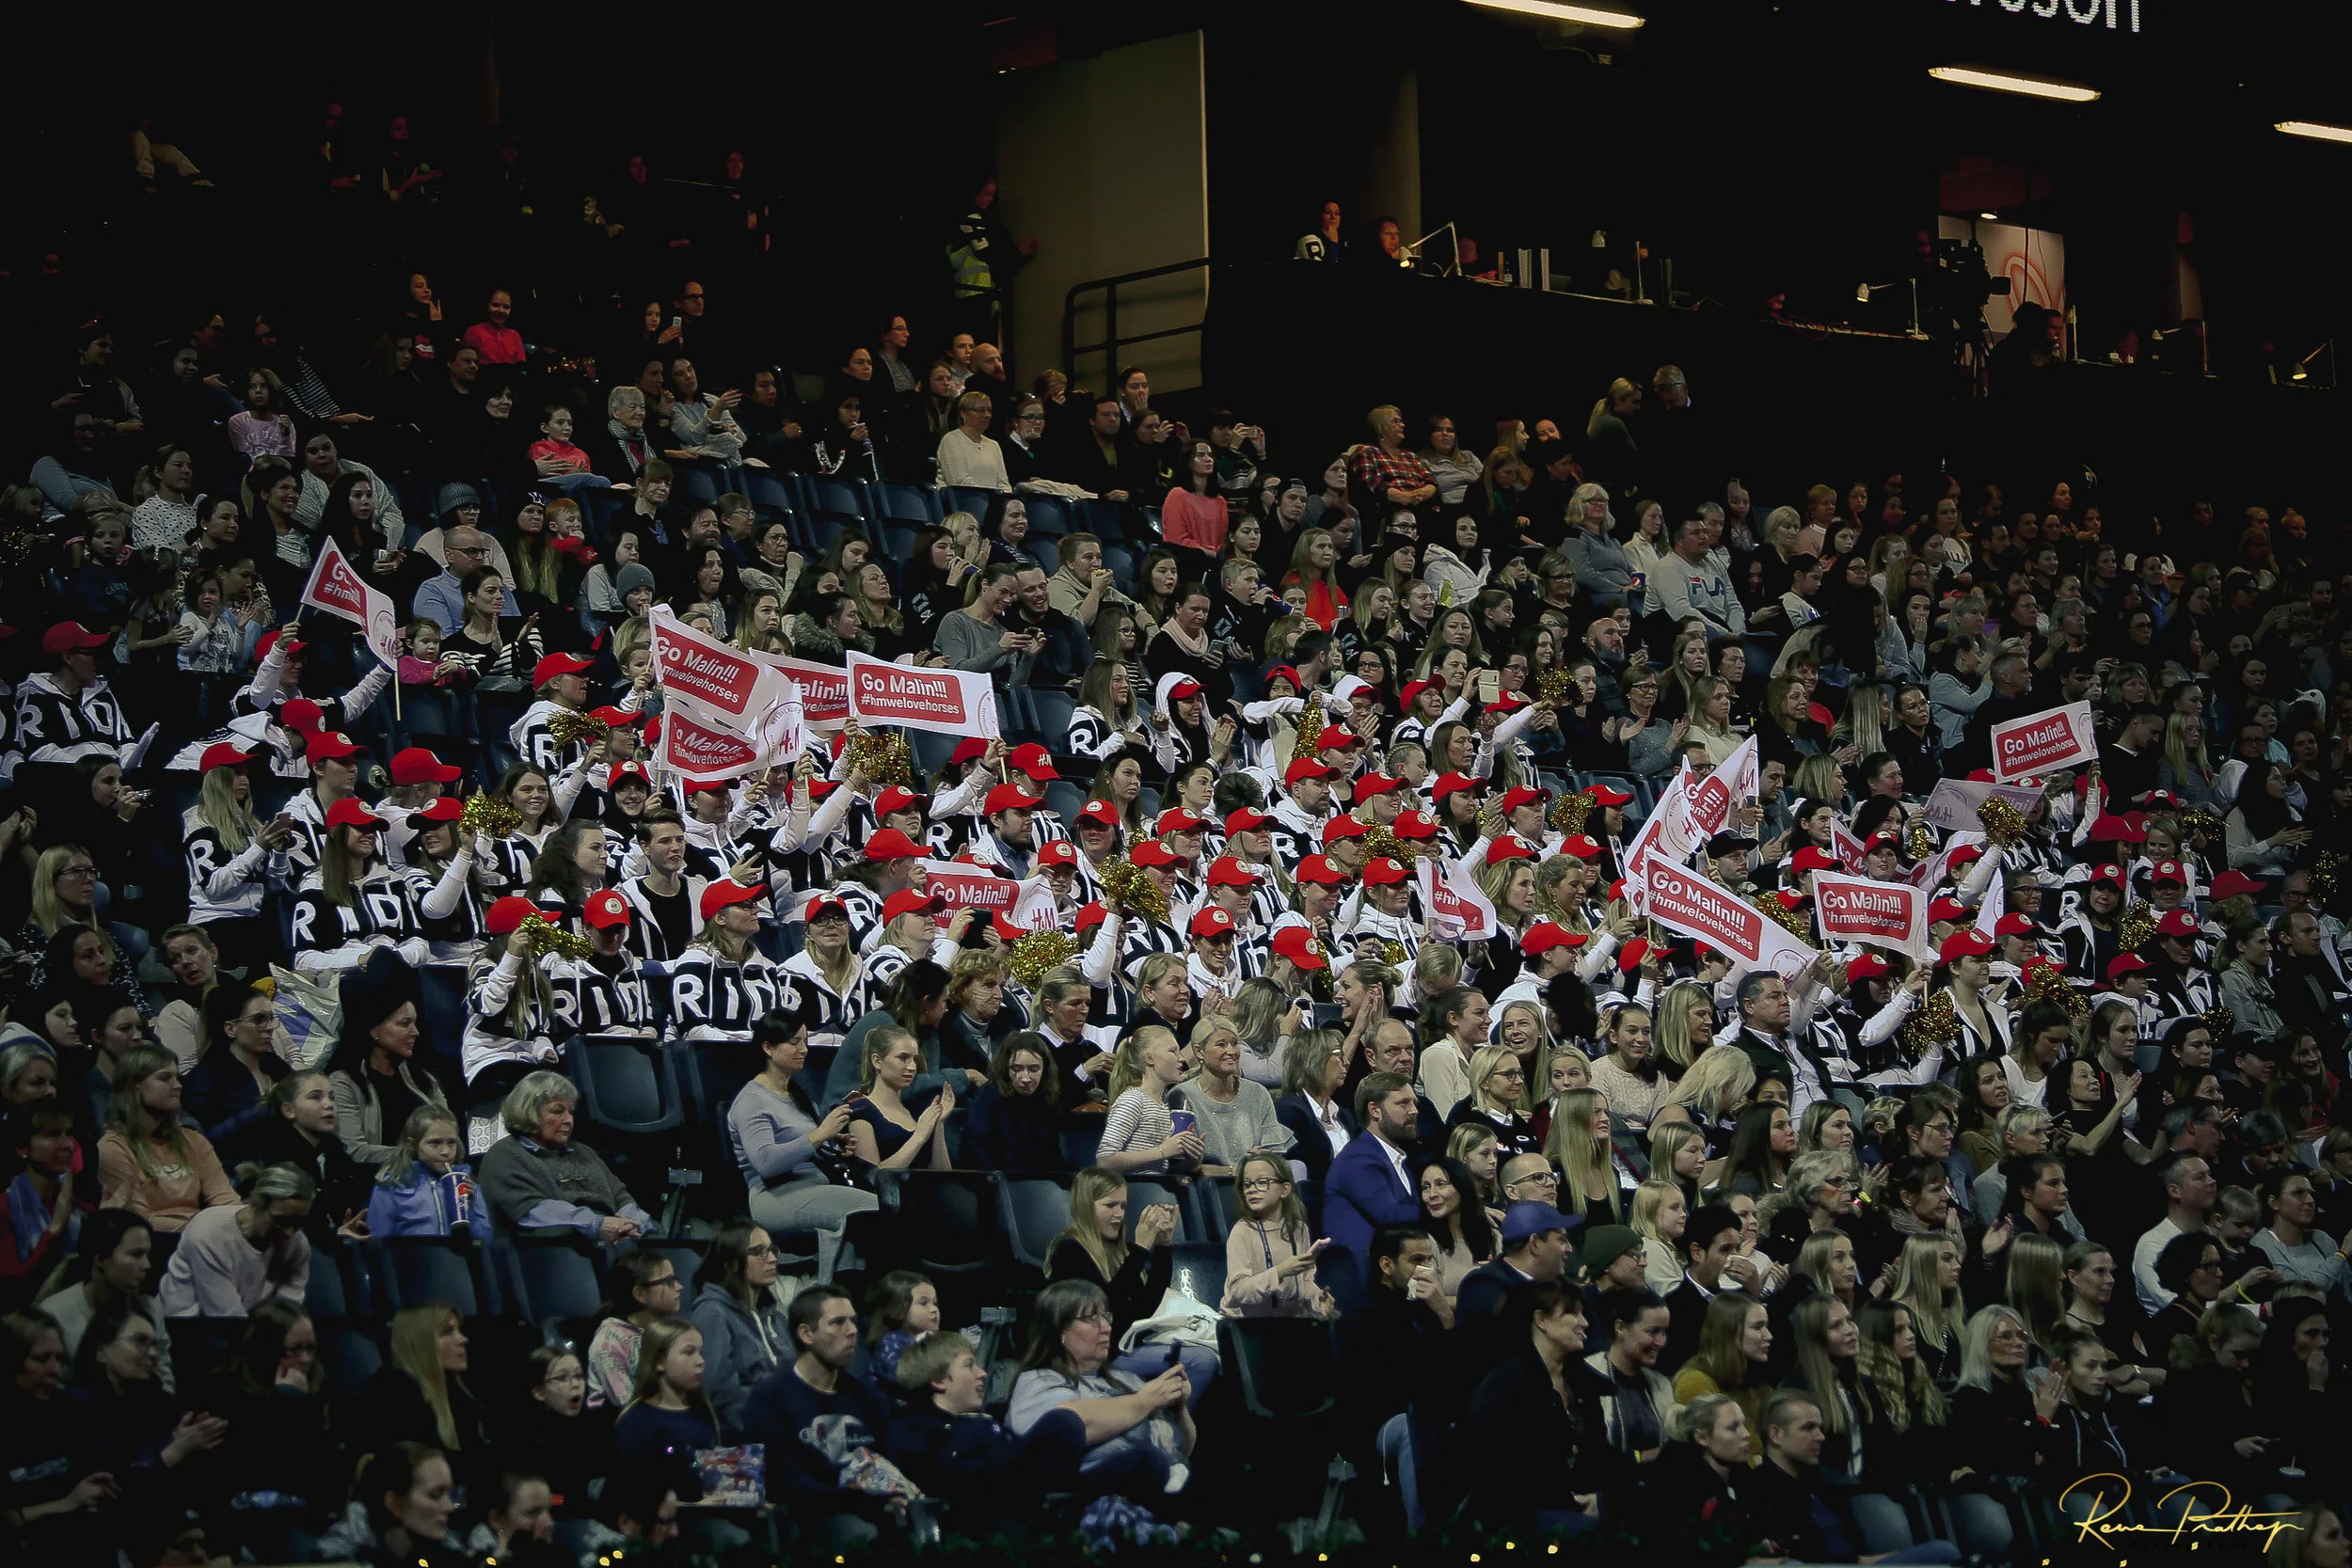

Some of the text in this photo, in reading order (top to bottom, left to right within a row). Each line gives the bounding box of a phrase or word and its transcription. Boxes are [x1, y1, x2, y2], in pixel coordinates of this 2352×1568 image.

[657, 636, 740, 684] Go Malin!!!
[662, 663, 740, 704] mwelovehorses
[860, 673, 948, 699] Go Malin!!!
[860, 693, 960, 715] #hmwelovehorses
[2004, 738, 2024, 754] Go
[930, 881, 1011, 905] Go Malin!!!
[1652, 870, 1747, 932] Go Malin!!!
[1822, 889, 1902, 915] Go Malin!!!
[1648, 889, 1755, 951] #hmwelovehorses
